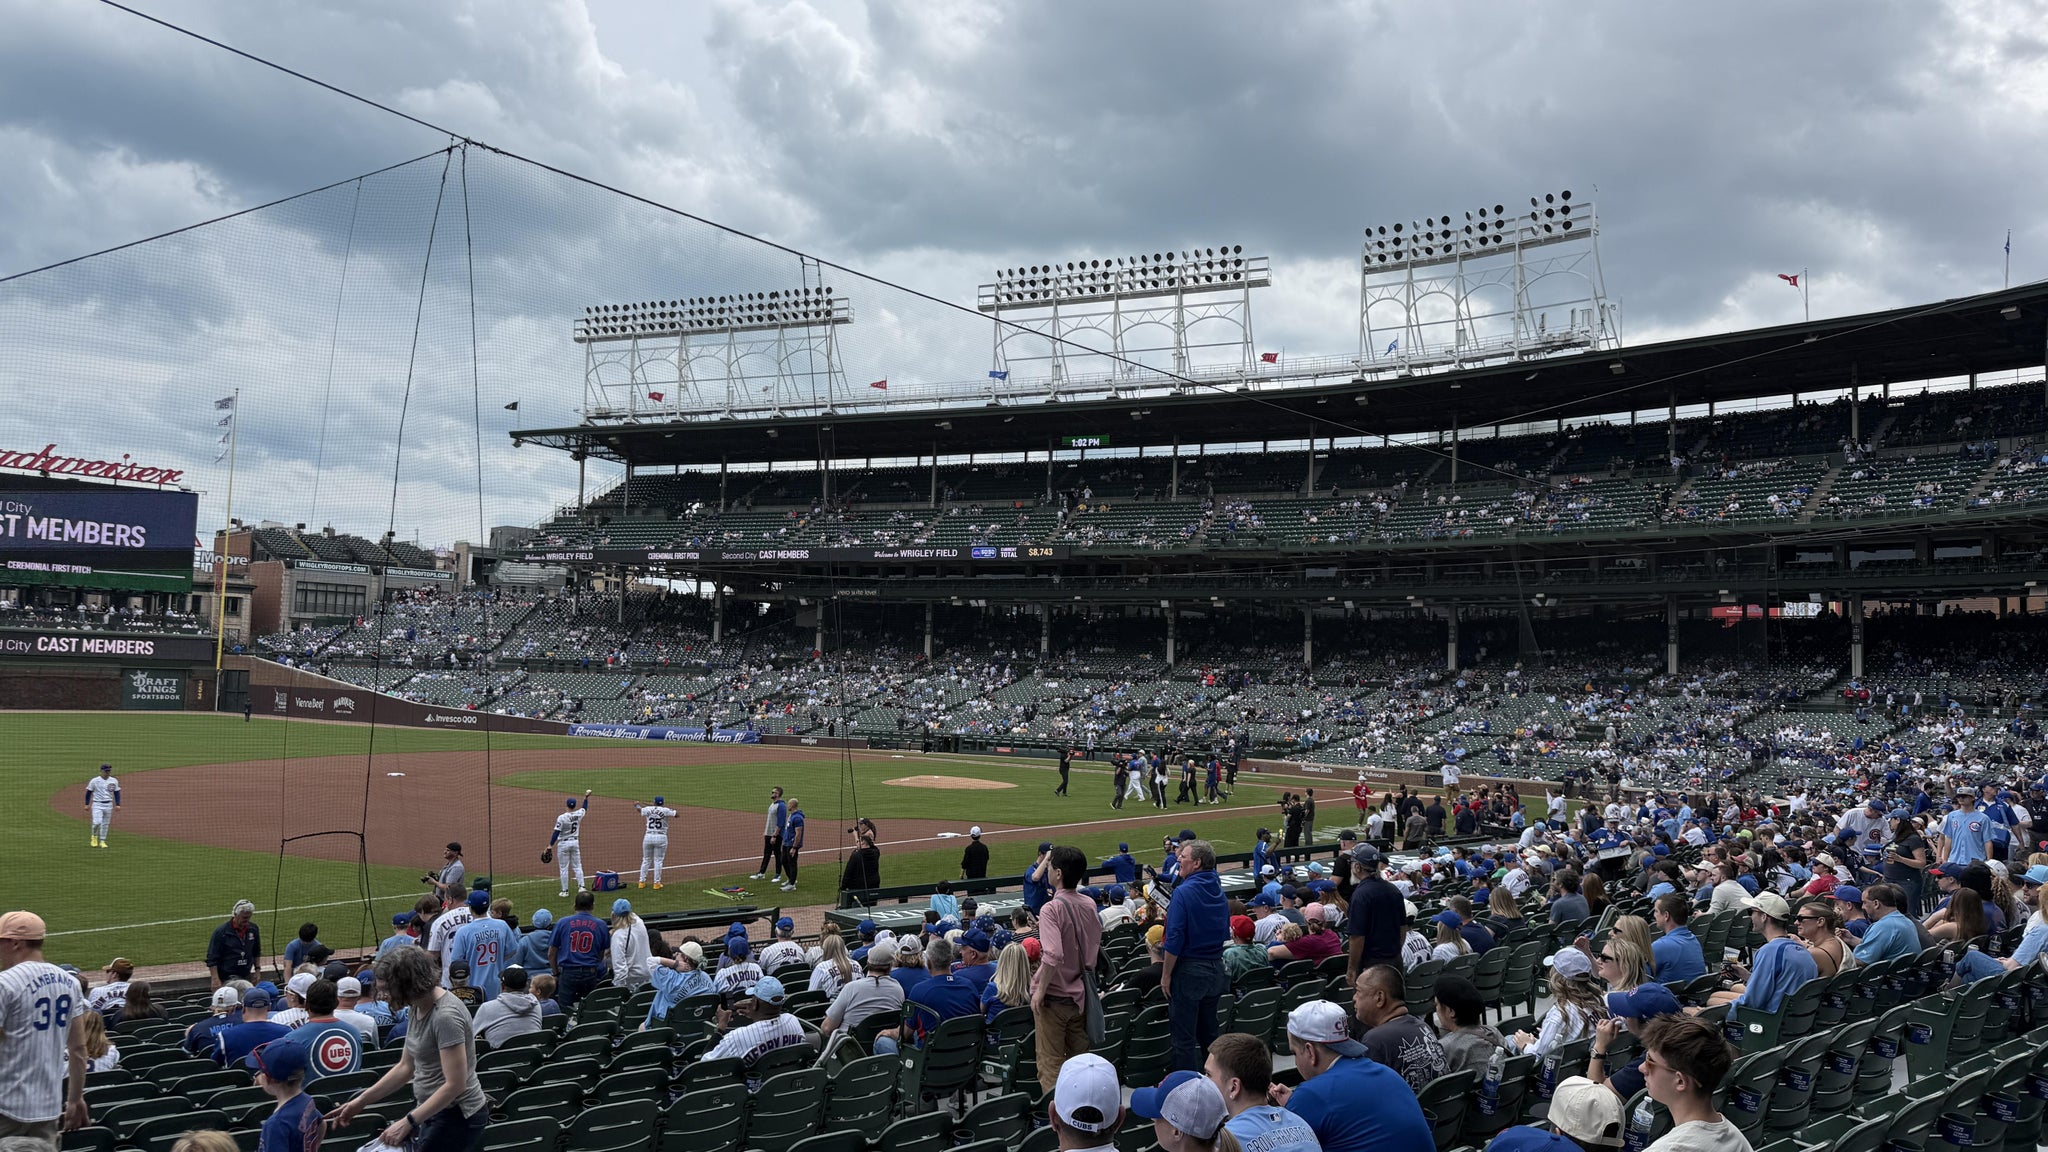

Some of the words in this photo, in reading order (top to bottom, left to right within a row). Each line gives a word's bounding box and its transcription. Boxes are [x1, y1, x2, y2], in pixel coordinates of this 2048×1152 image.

[1072, 438, 1087, 447] 1:02
[1088, 438, 1100, 446] PM
[0, 444, 183, 484] udweiser
[6, 500, 32, 516] City
[27, 516, 146, 548] MEMBERS
[201, 550, 248, 566] Moore
[745, 552, 757, 560] City
[759, 551, 776, 559] CAST
[778, 550, 809, 559] MEMBERS
[1028, 548, 1053, 556] $8,743
[8, 560, 50, 572] CEREMONIAL
[52, 563, 70, 572] FIRST
[71, 564, 91, 574] PITCH
[6, 639, 32, 653] City
[38, 636, 79, 652] CAST
[82, 638, 154, 655] MEMBERS
[133, 677, 178, 687] DRAFT
[435, 714, 462, 723] Invesco
[462, 716, 477, 724] QQQ
[575, 726, 612, 738] Reynolds
[613, 728, 637, 739] Wrap
[664, 730, 706, 742] Reynolds
[1301, 765, 1332, 774] TimberTech
[648, 818, 662, 829] 25
[441, 914, 472, 931] CLEME
[475, 930, 499, 942] BUSCH
[570, 931, 594, 953] 10
[476, 942, 498, 967] 29
[781, 949, 797, 958] SOSA
[27, 973, 72, 994] ZAMBRANO
[33, 994, 71, 1031] 38
[1072, 1120, 1093, 1130] CUBS
